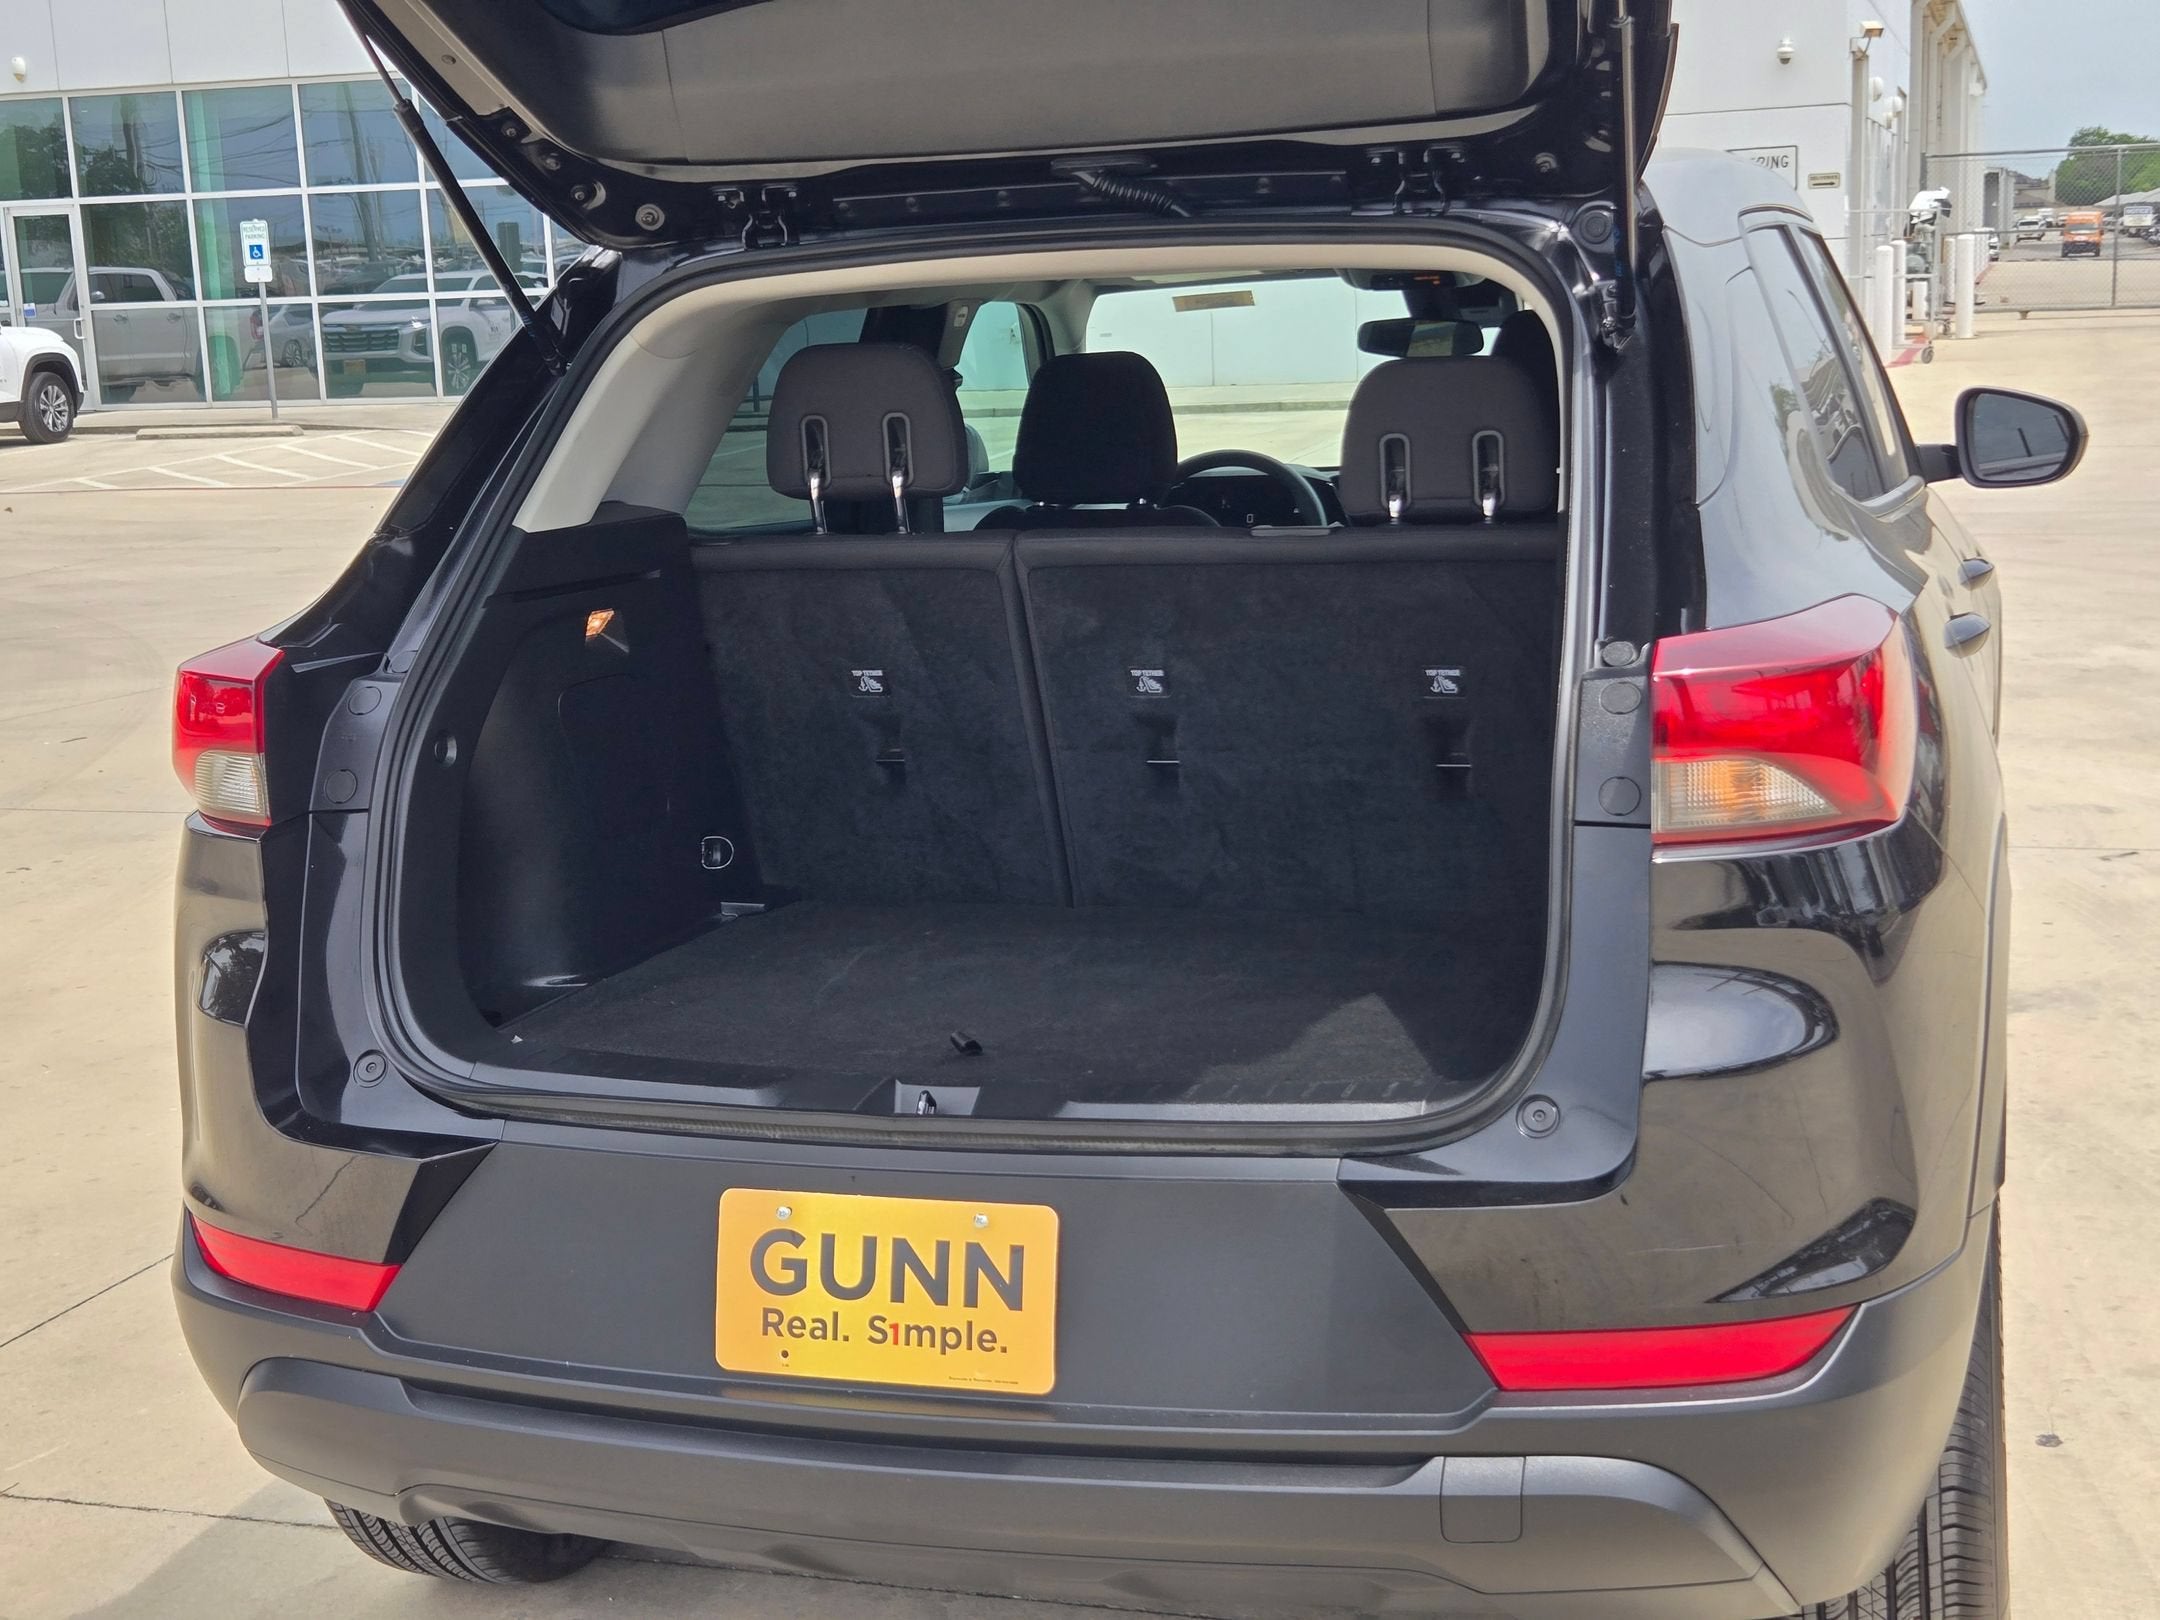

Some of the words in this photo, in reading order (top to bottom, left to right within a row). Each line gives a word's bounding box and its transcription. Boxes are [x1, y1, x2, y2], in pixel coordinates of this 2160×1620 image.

[750, 1228, 1025, 1312] GUNN
[762, 1307, 850, 1342] Real.
[867, 1315, 1008, 1355] S1mple.
